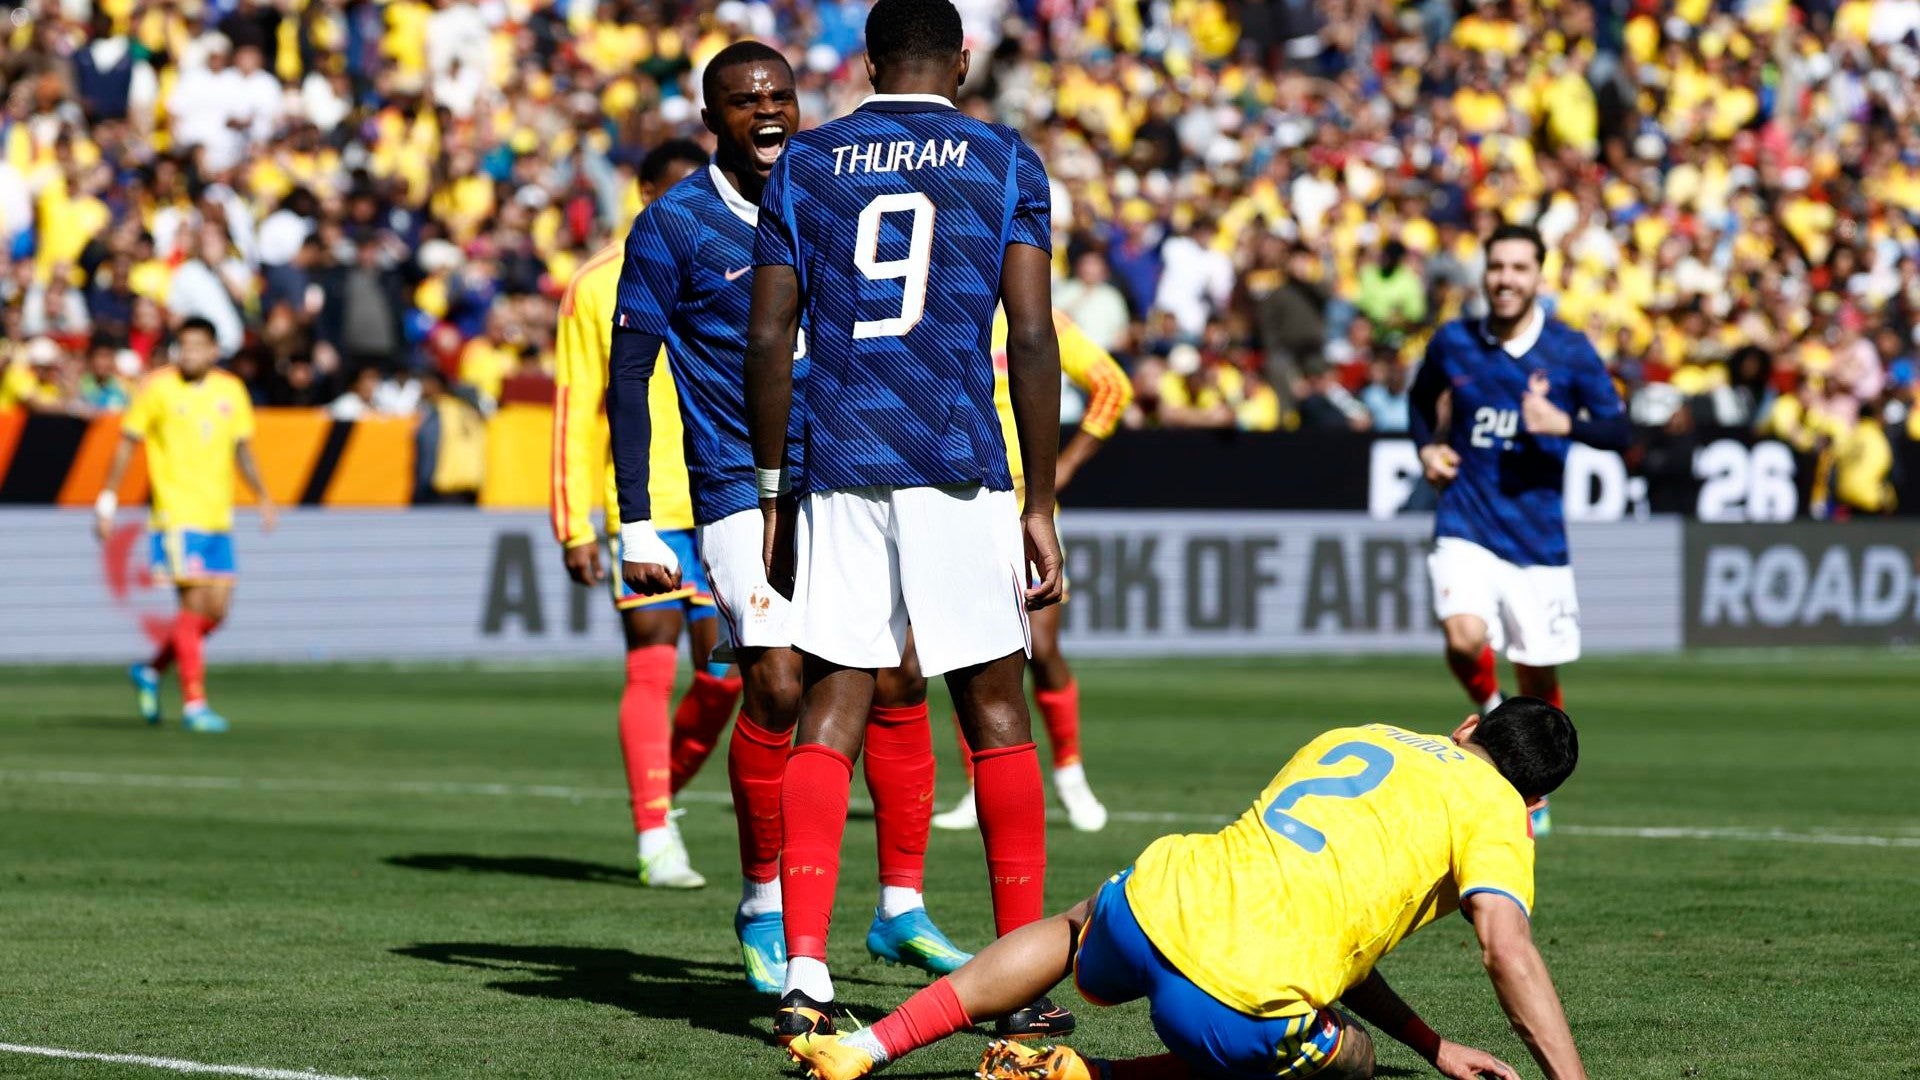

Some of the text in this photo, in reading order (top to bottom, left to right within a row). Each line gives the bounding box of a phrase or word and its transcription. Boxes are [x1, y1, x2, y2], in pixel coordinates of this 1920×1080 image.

[833, 139, 968, 176] THURAM
[853, 192, 936, 339] 9
[1471, 406, 1520, 450] 24
[1692, 439, 1798, 523] 26
[483, 533, 544, 633] A
[1184, 538, 1279, 632] OF
[1702, 545, 1912, 626] ROAD
[1263, 741, 1395, 853] 2
